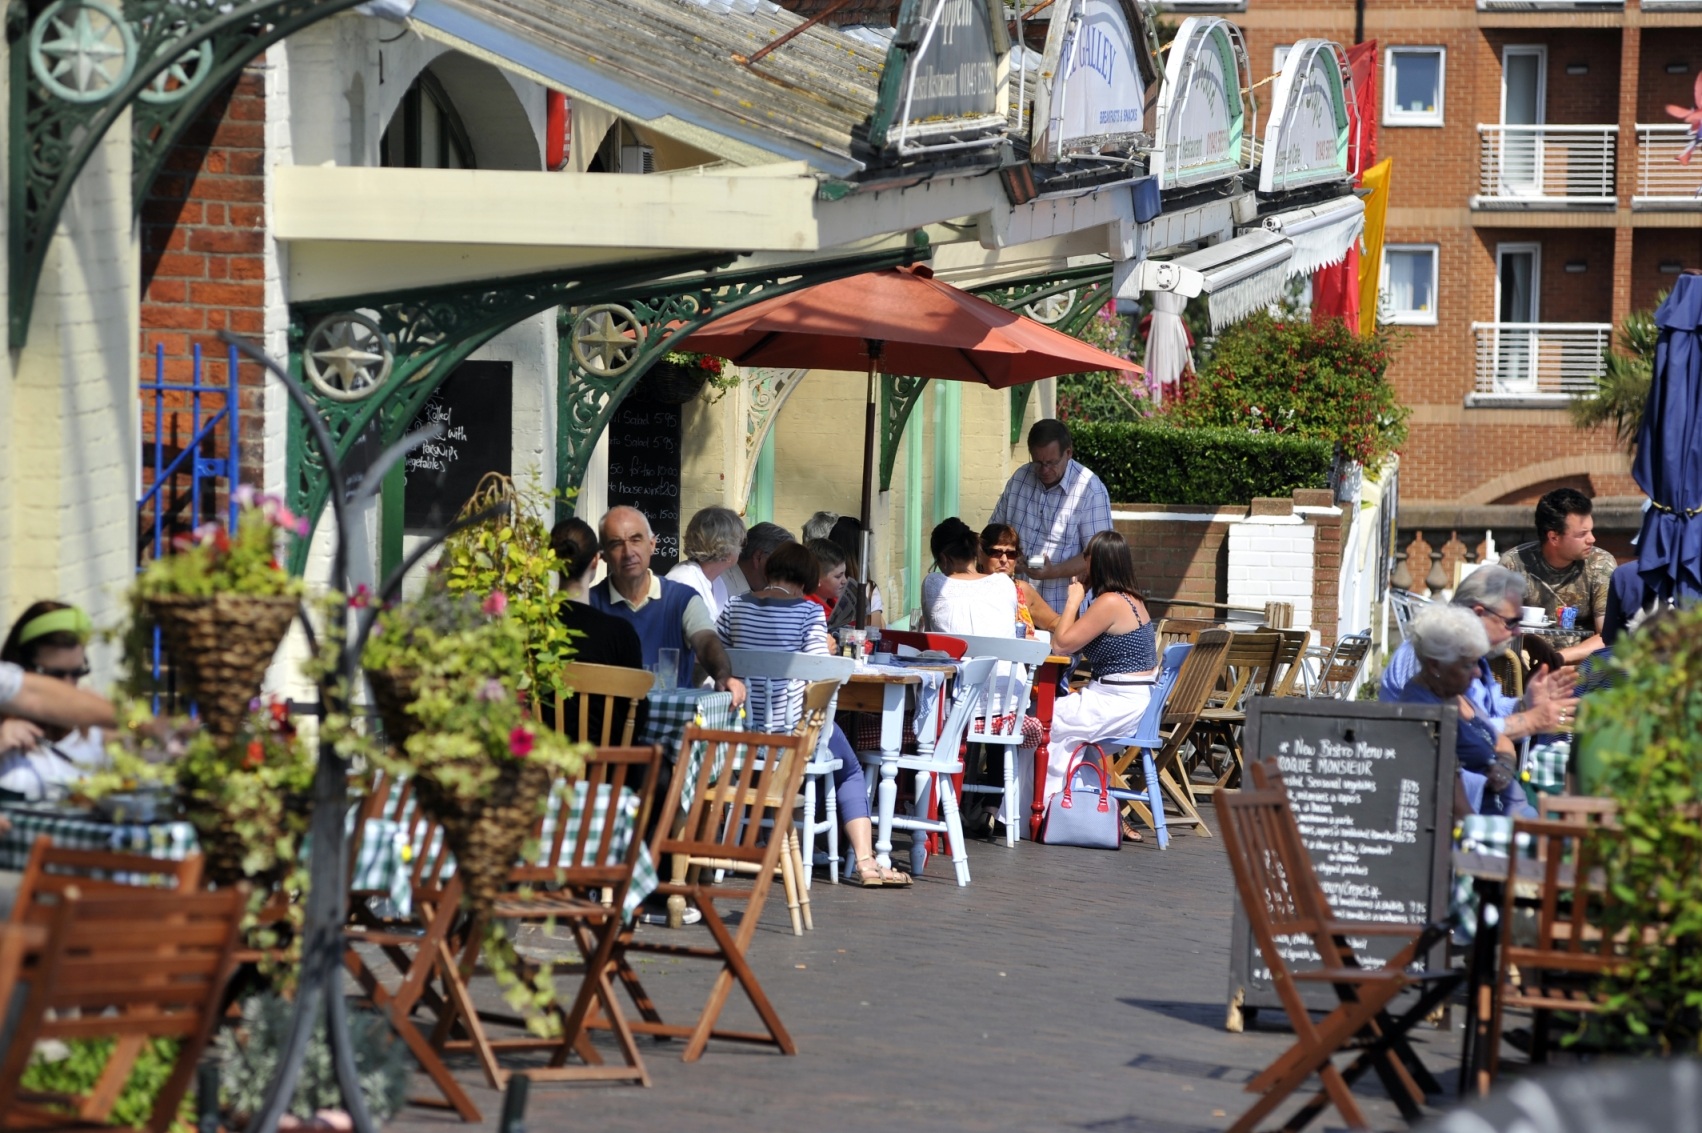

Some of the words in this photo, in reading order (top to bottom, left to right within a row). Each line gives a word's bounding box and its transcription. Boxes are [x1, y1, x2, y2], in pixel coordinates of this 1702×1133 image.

[1079, 24, 1116, 88] GALLEY
[1123, 108, 1137, 122] SNACKS
[623, 410, 649, 425] Salad
[448, 426, 467, 441] with
[624, 434, 649, 448] Salad
[1294, 739, 1316, 757] New
[1319, 738, 1354, 758] Bistro
[1355, 741, 1383, 759] Menu
[1317, 758, 1373, 776] MONSIEUR
